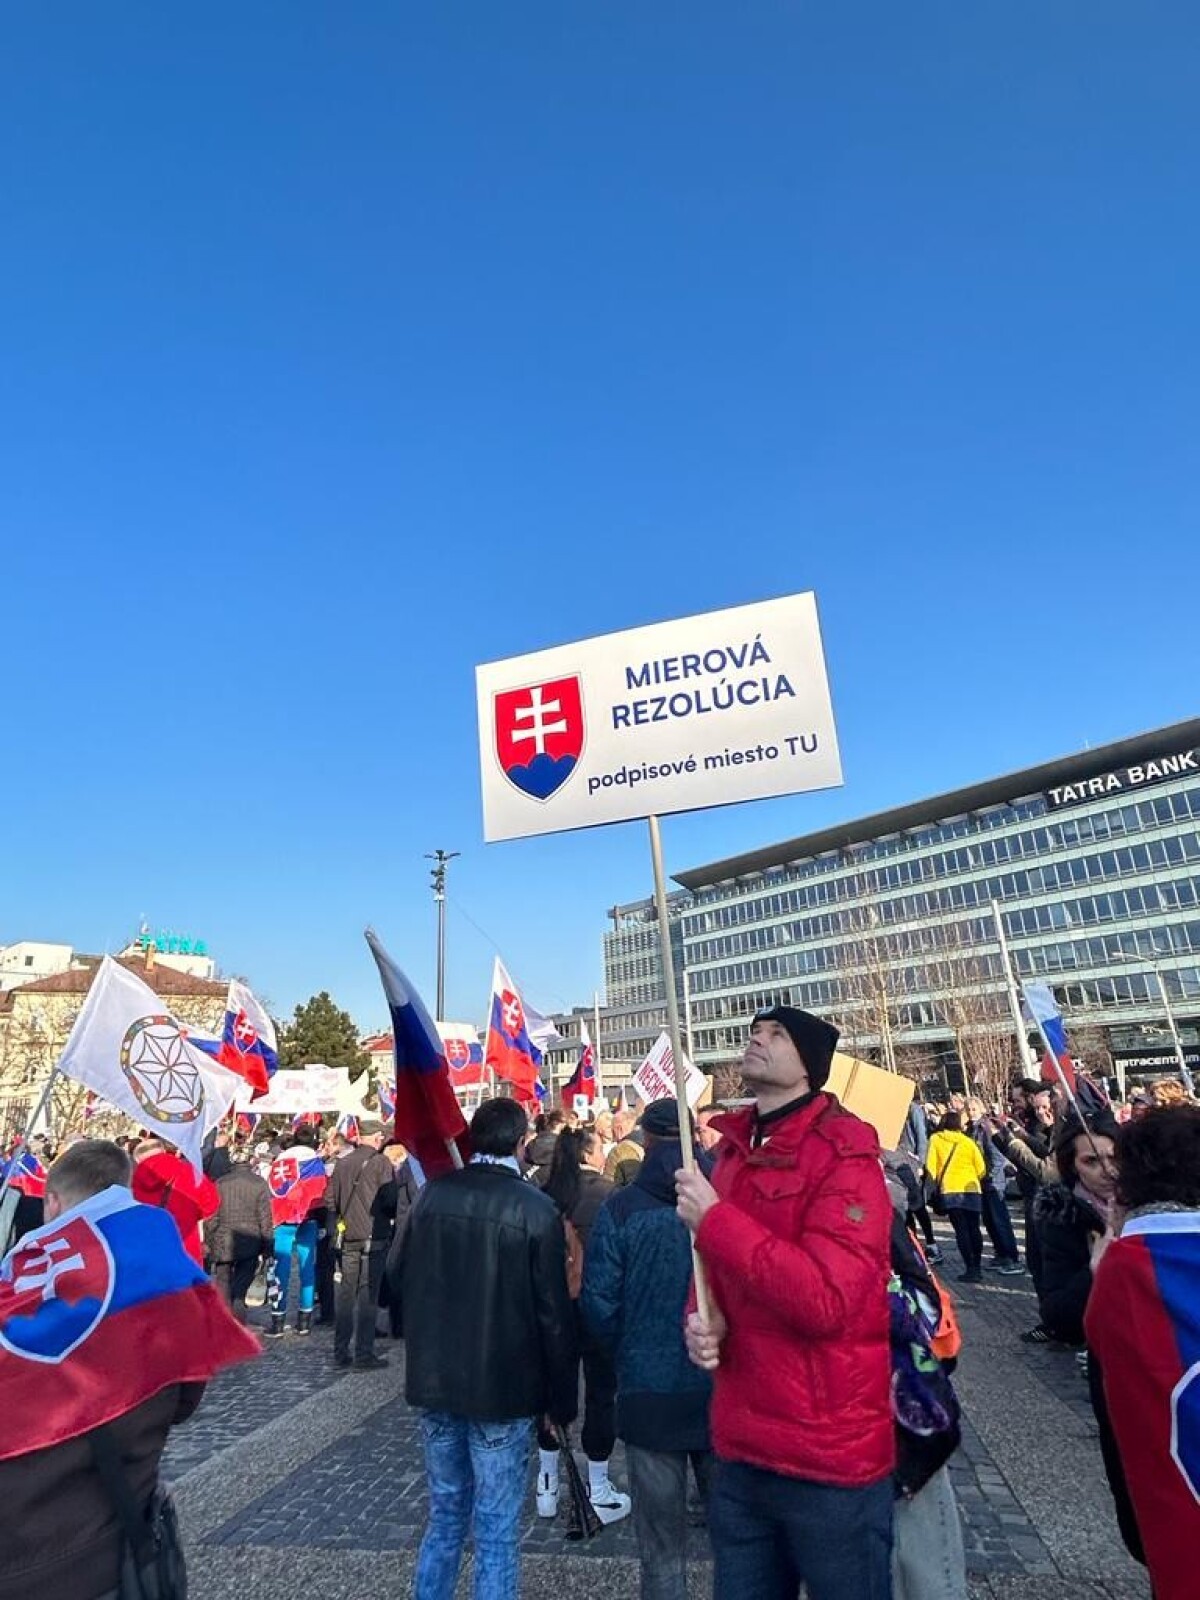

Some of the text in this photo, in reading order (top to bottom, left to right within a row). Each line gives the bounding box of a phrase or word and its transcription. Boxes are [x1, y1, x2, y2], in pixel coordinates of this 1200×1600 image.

[625, 634, 771, 690] MIEROVÁ
[612, 675, 796, 729] REZOLÚCIA
[588, 733, 818, 795] podpisové miesto TU
[1049, 751, 1199, 804] TATRA BANK
